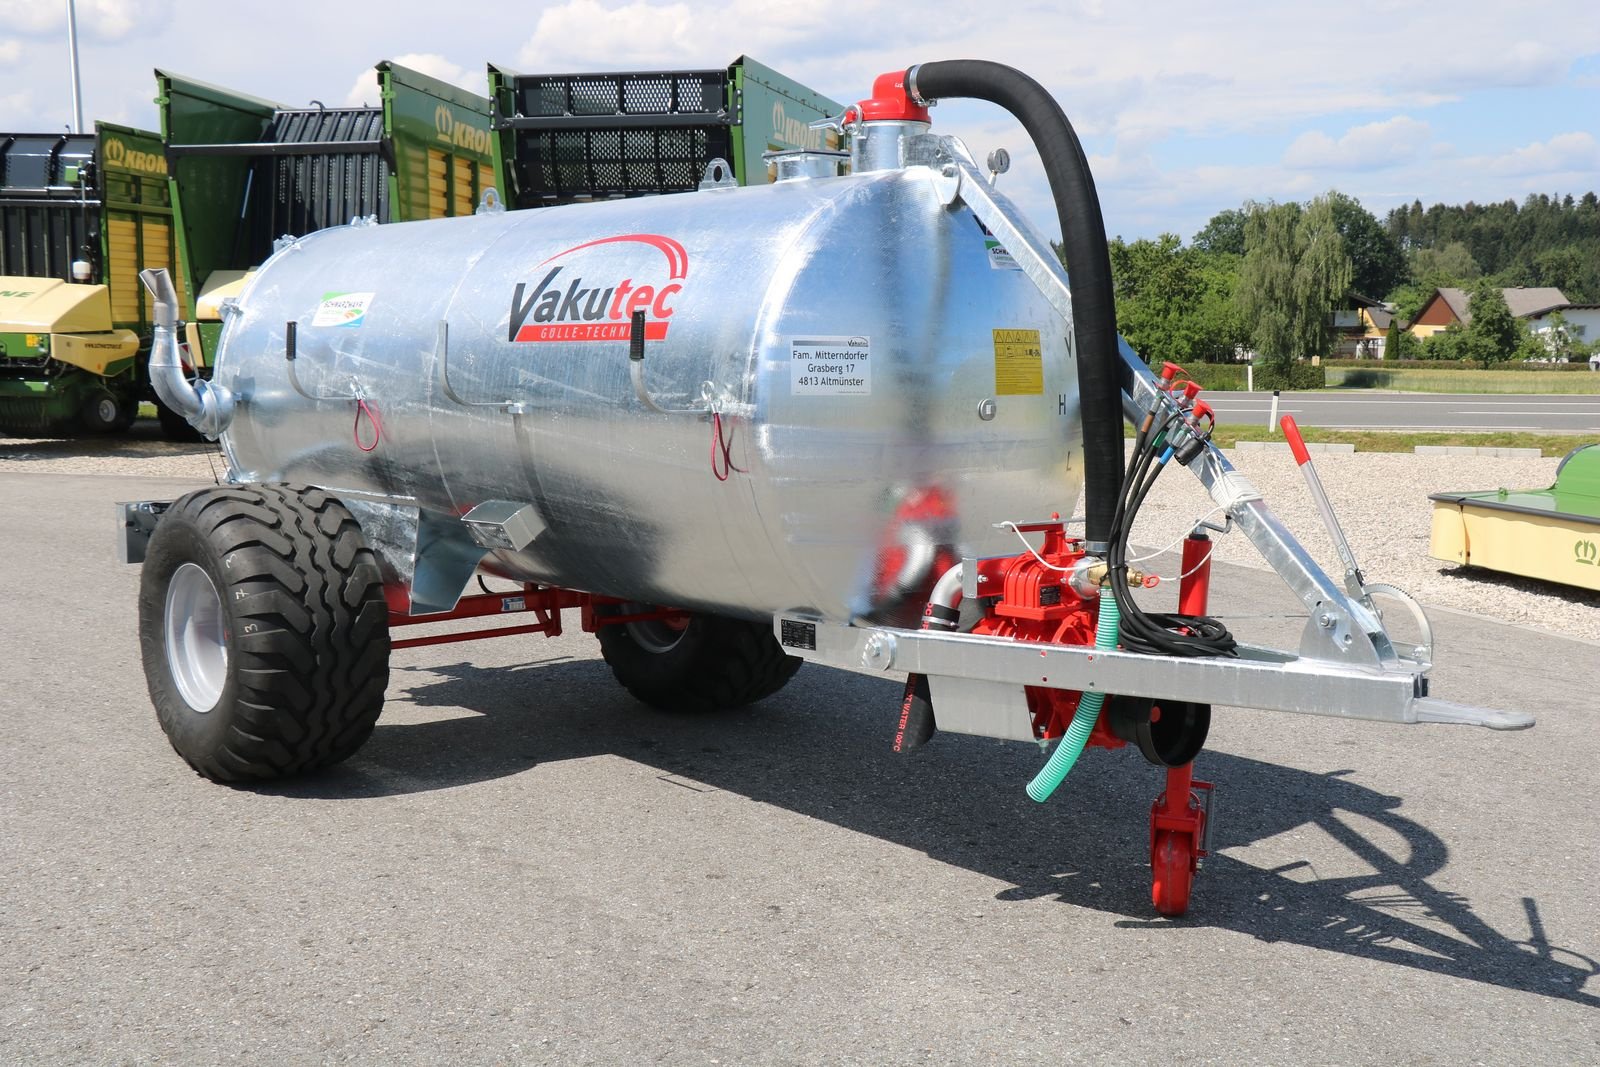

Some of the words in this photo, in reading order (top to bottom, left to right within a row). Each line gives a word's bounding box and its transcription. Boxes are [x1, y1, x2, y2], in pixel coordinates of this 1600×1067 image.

[453, 121, 493, 157] KRON
[125, 149, 168, 174] KRON
[508, 265, 683, 342] Vakutec
[540, 325, 632, 339] GÜLLE-TECHNI
[792, 350, 813, 360] Fam.
[815, 350, 869, 360] Mitterndorfer
[807, 363, 844, 375] Grasberg
[846, 363, 855, 373] 17
[798, 376, 819, 386] 4813
[820, 376, 864, 386] Altmünster
[1058, 394, 1066, 416] H
[898, 702, 912, 730] WATER
